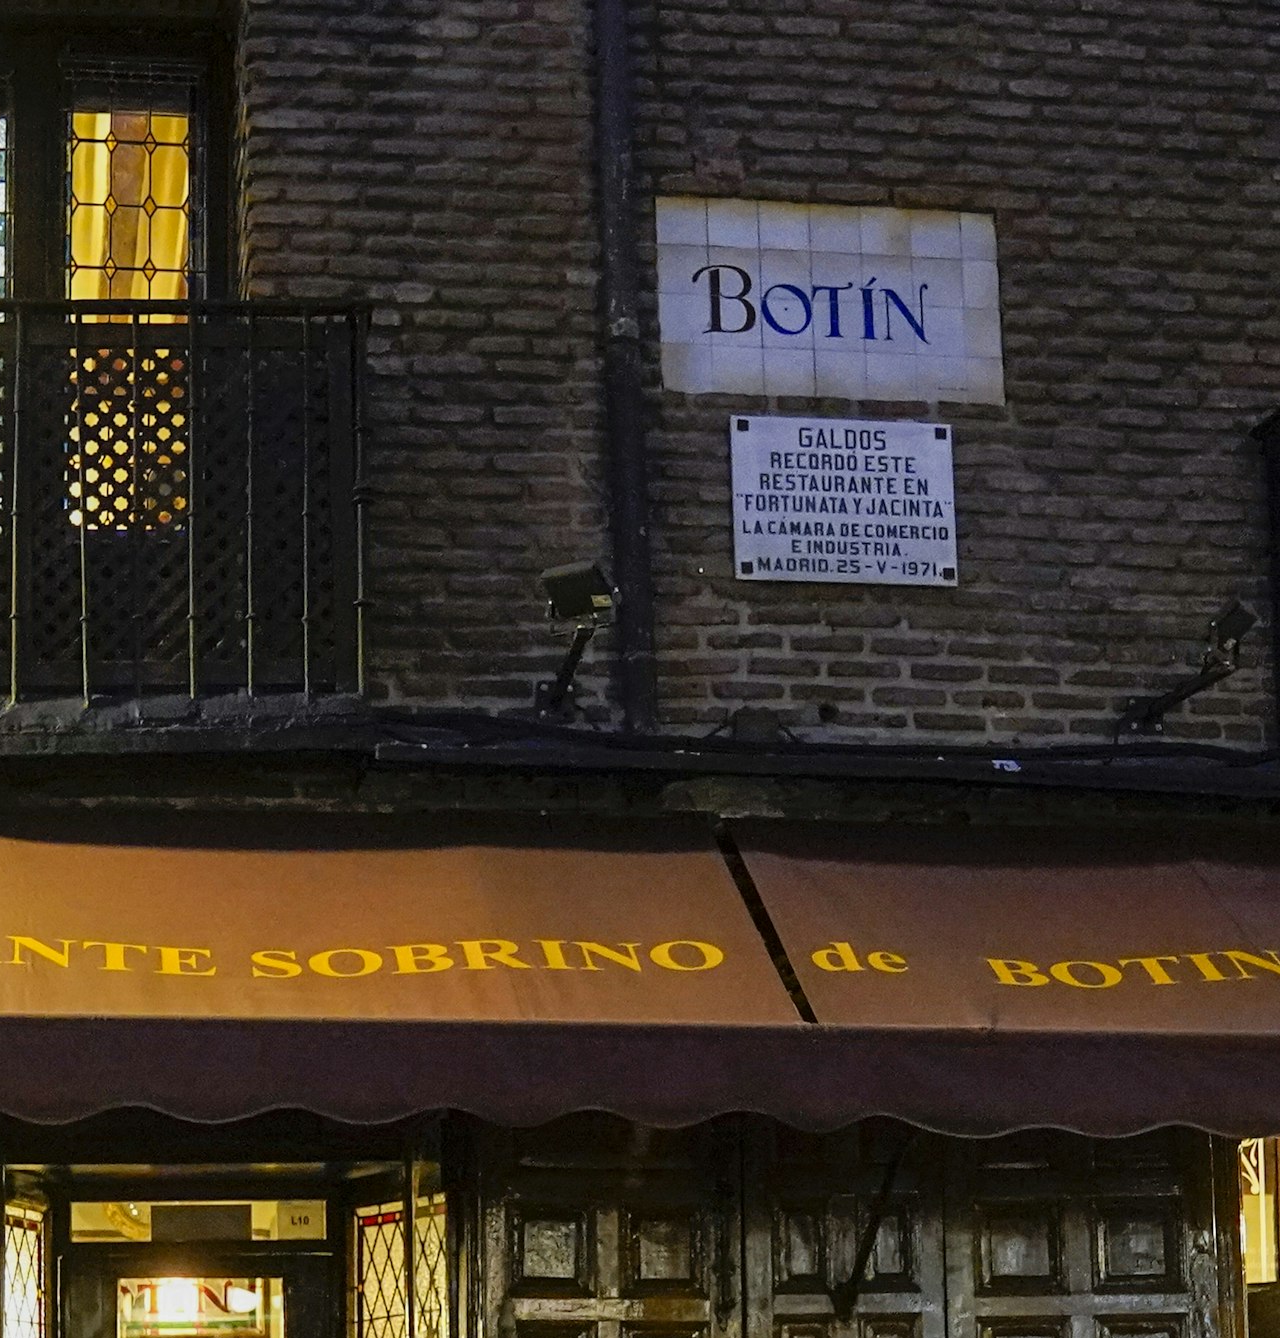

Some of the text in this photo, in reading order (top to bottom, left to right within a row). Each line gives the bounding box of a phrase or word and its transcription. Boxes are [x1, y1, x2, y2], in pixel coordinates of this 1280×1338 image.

[798, 427, 887, 451] GALDOS
[770, 450, 916, 474] RECORDÓ ESTE
[759, 473, 929, 496] RESTAURANTE EN
[850, 497, 863, 515] Y
[742, 516, 949, 541] LA CÁMARA DE COMERCIO
[791, 539, 802, 554] E
[251, 938, 725, 978] SOBRINO
[811, 941, 910, 973] de
[290, 1215, 310, 1226] L10
